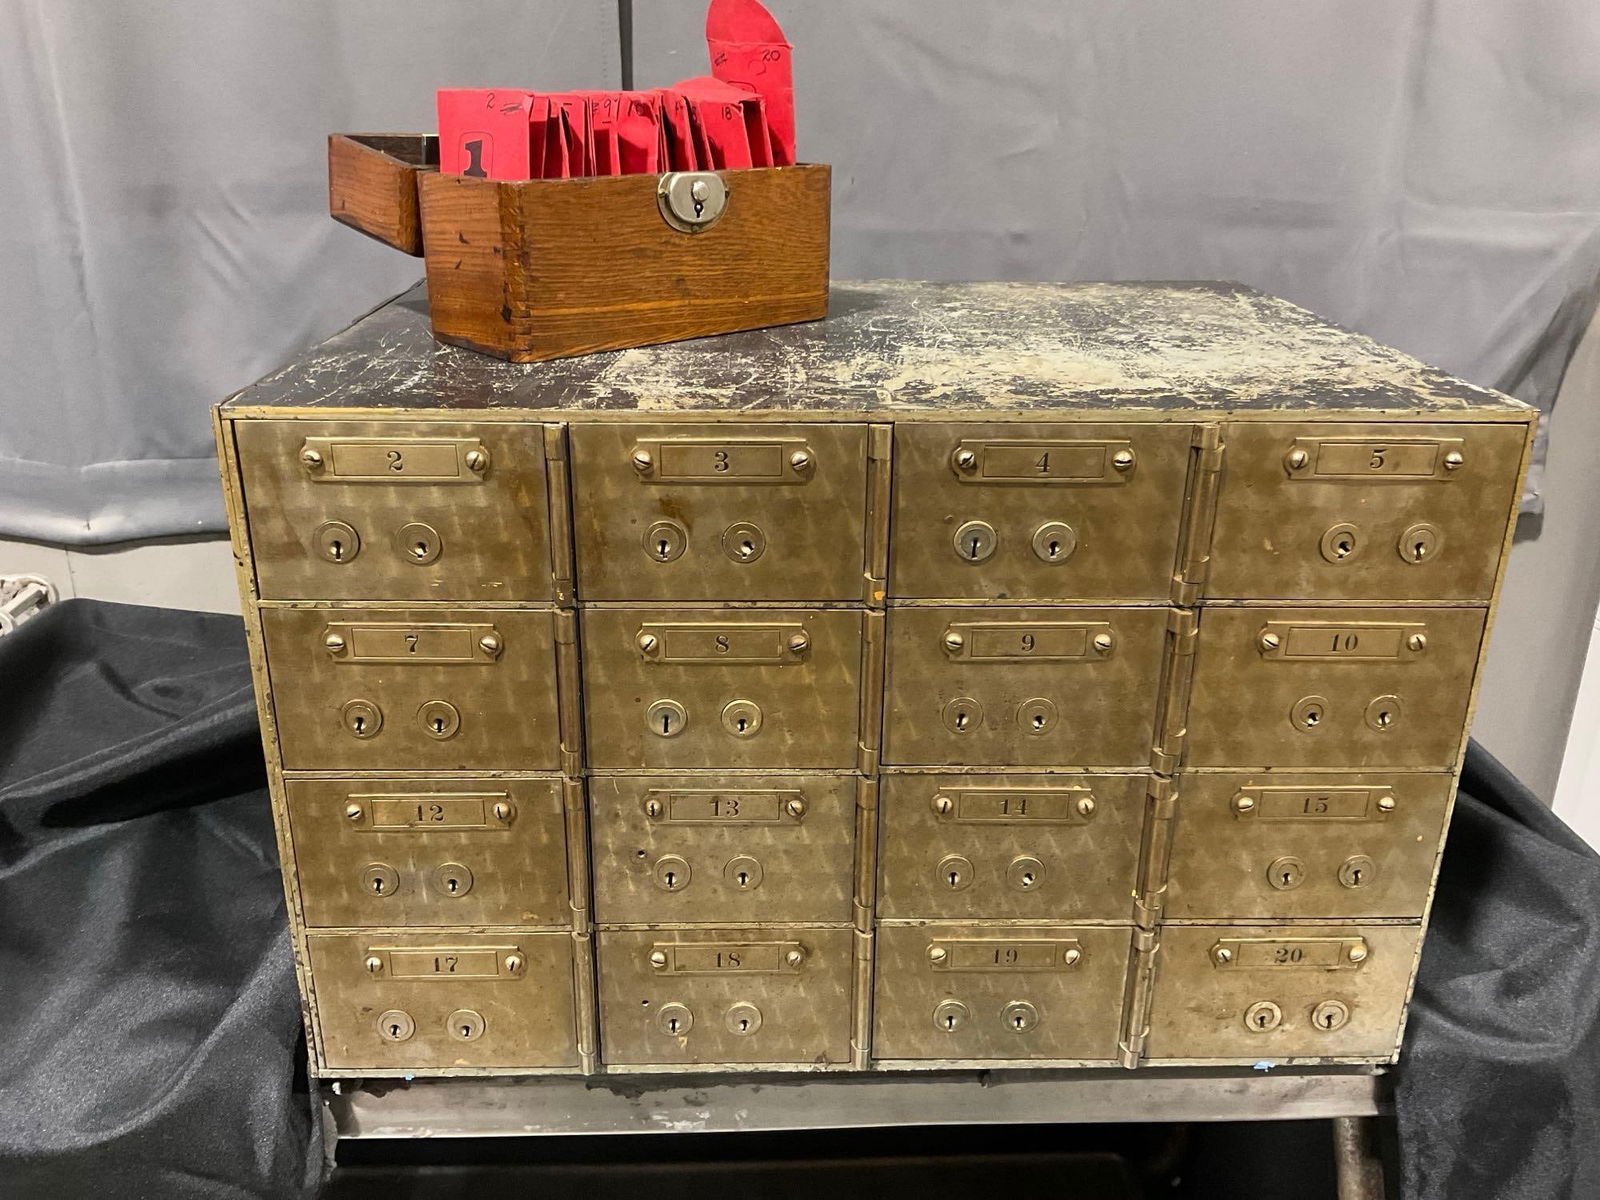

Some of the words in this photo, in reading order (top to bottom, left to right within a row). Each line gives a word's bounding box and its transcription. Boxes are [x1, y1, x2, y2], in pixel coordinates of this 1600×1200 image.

[762, 49, 781, 62] 20
[463, 139, 488, 178] 1
[386, 450, 403, 471] 2
[714, 451, 729, 472] 3
[1035, 452, 1050, 473] 4
[1369, 448, 1389, 469] 5
[404, 634, 419, 654] 7
[714, 635, 730, 654] 8
[1021, 633, 1035, 652] 9
[1330, 633, 1359, 653] 10
[415, 804, 444, 823] 12
[710, 798, 740, 818] 13
[997, 798, 1028, 816] 14
[1302, 796, 1330, 815] 15
[433, 956, 459, 973] 17
[715, 952, 741, 969] 18
[993, 948, 1018, 965] 19
[1273, 947, 1303, 964] 20
